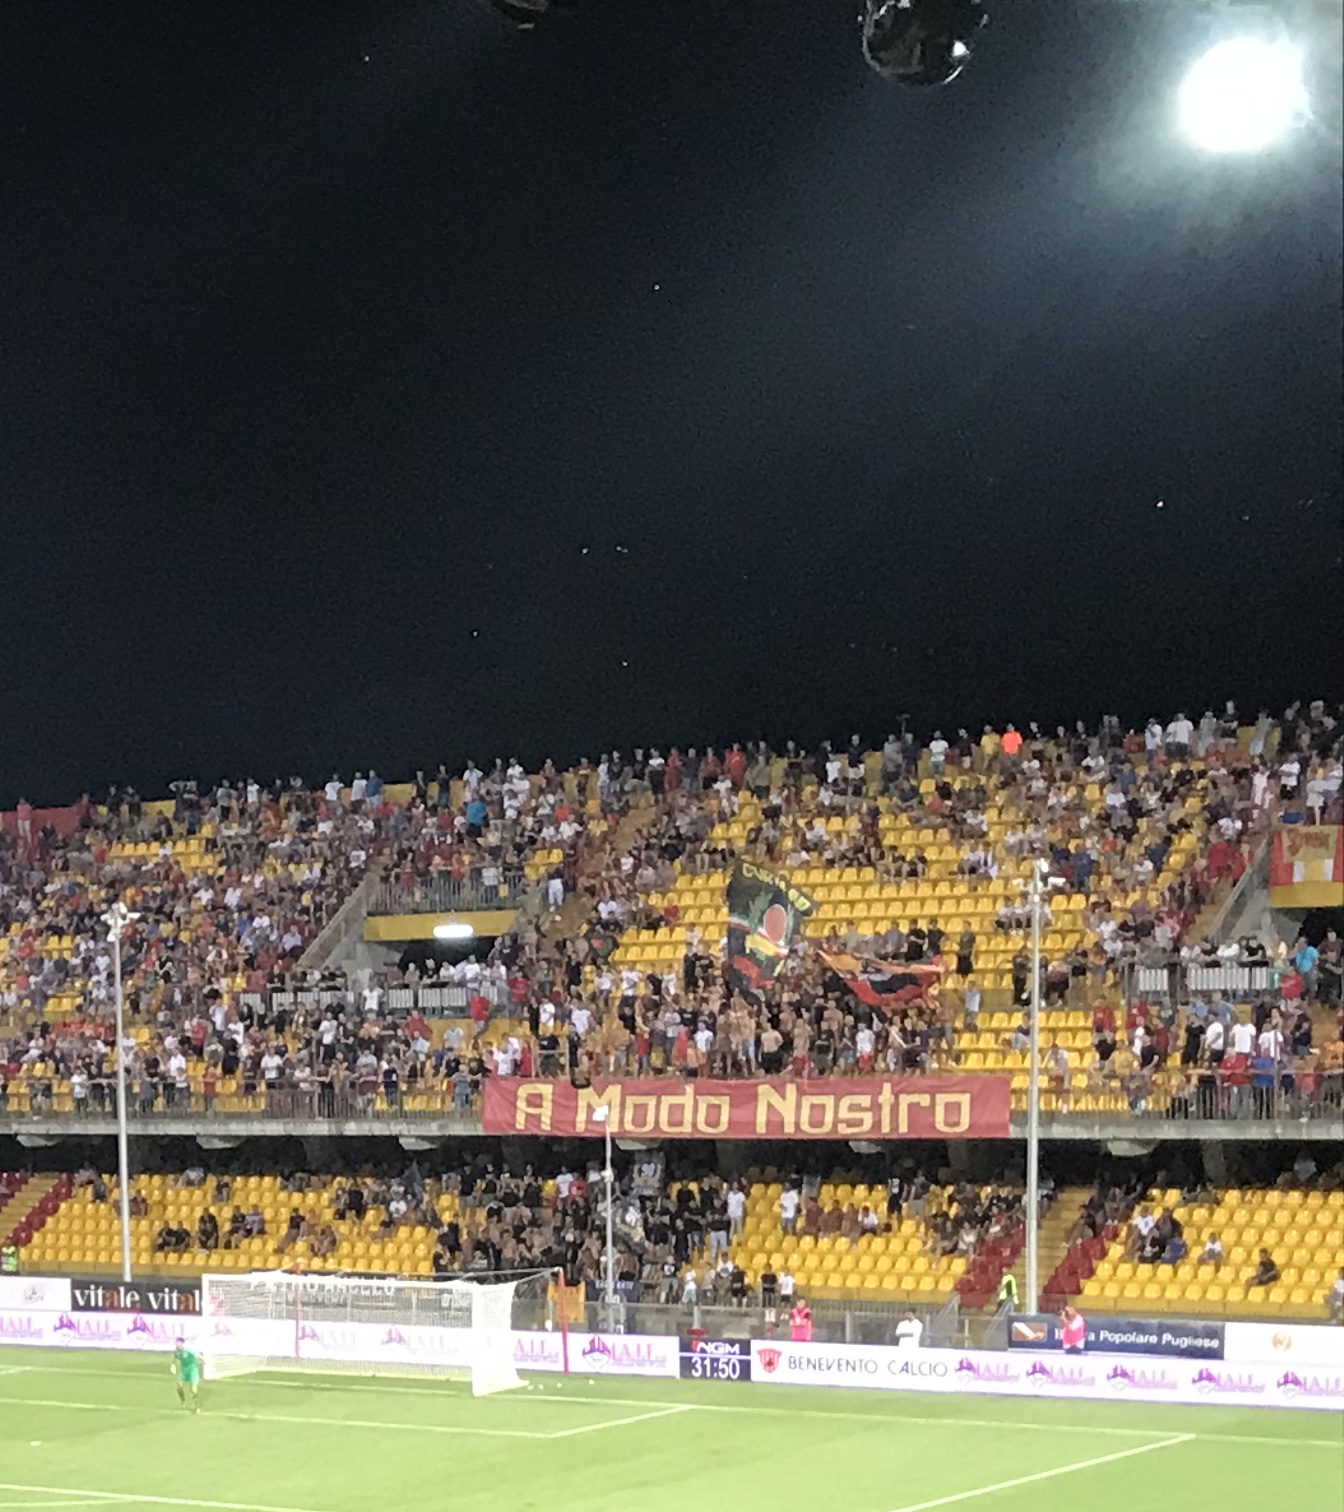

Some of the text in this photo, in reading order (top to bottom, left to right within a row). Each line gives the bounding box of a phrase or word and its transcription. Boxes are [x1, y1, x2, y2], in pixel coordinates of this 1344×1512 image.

[515, 1082, 972, 1134] A Modo Nostro
[74, 1283, 140, 1308] vitale
[146, 1286, 203, 1312] vital
[691, 1358, 741, 1380] 31:50
[788, 1355, 948, 1378] BENEVENTO CALCIO
